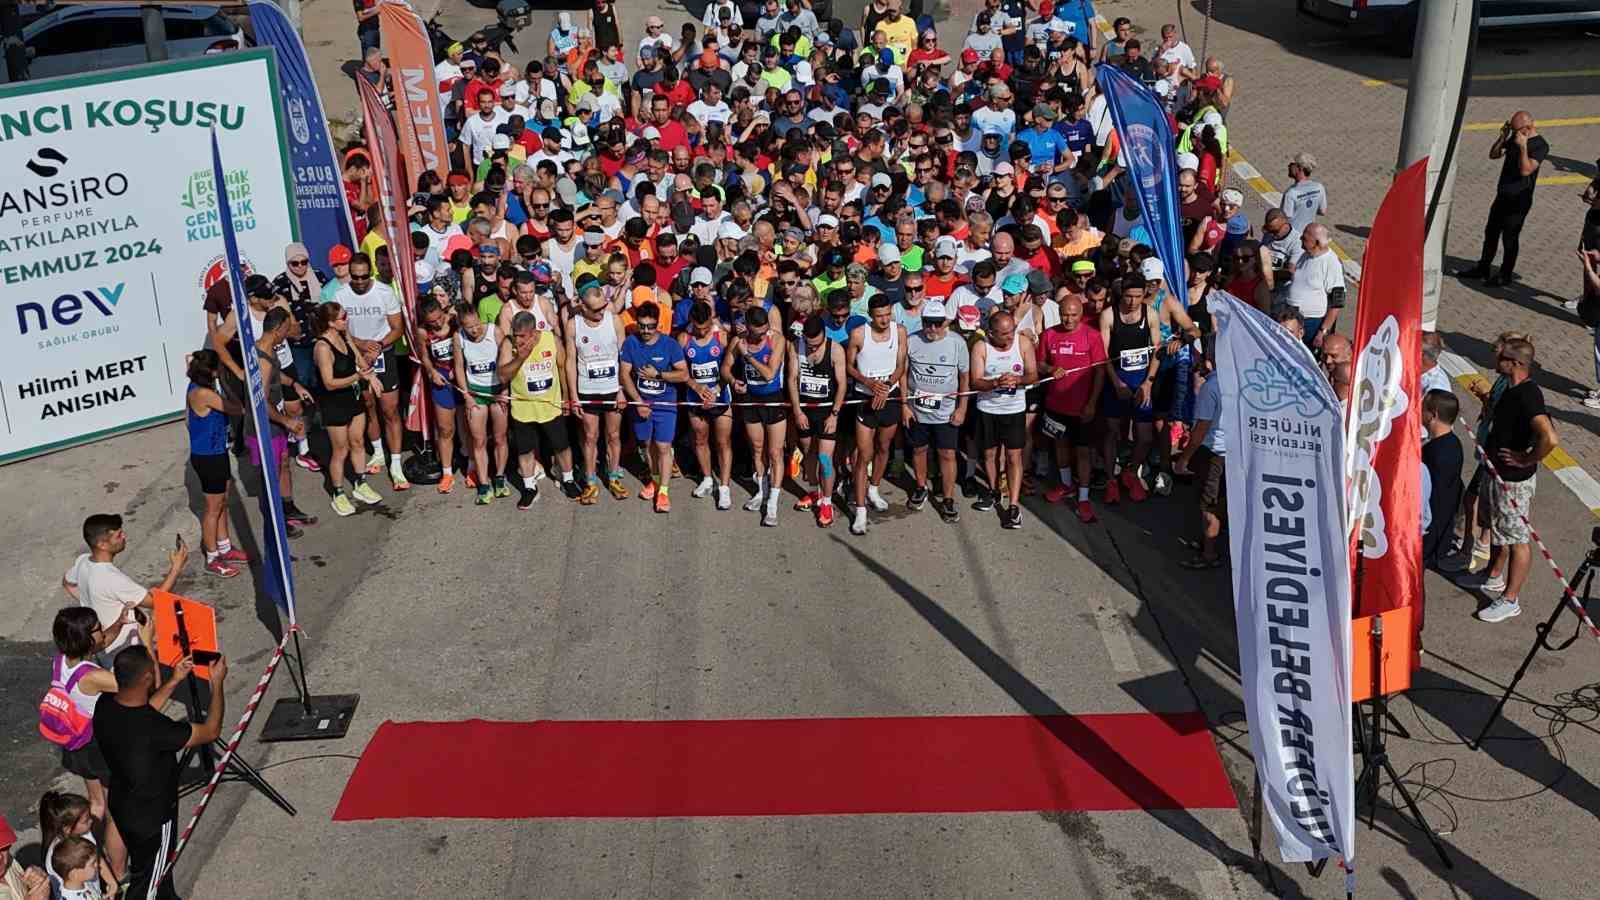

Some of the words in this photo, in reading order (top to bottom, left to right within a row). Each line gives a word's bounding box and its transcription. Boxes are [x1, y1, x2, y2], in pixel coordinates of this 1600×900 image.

[0, 104, 72, 141] NCI
[85, 99, 245, 133] KOŞUSU
[21, 207, 94, 228] PERFUME
[187, 215, 256, 242] KULBÜ
[104, 238, 163, 264] 2024
[38, 334, 79, 350] SAĞLIK
[82, 325, 121, 341] GRUBU
[18, 370, 79, 400] Hilmi
[86, 355, 148, 384] MERT
[40, 384, 137, 420] ANISINA
